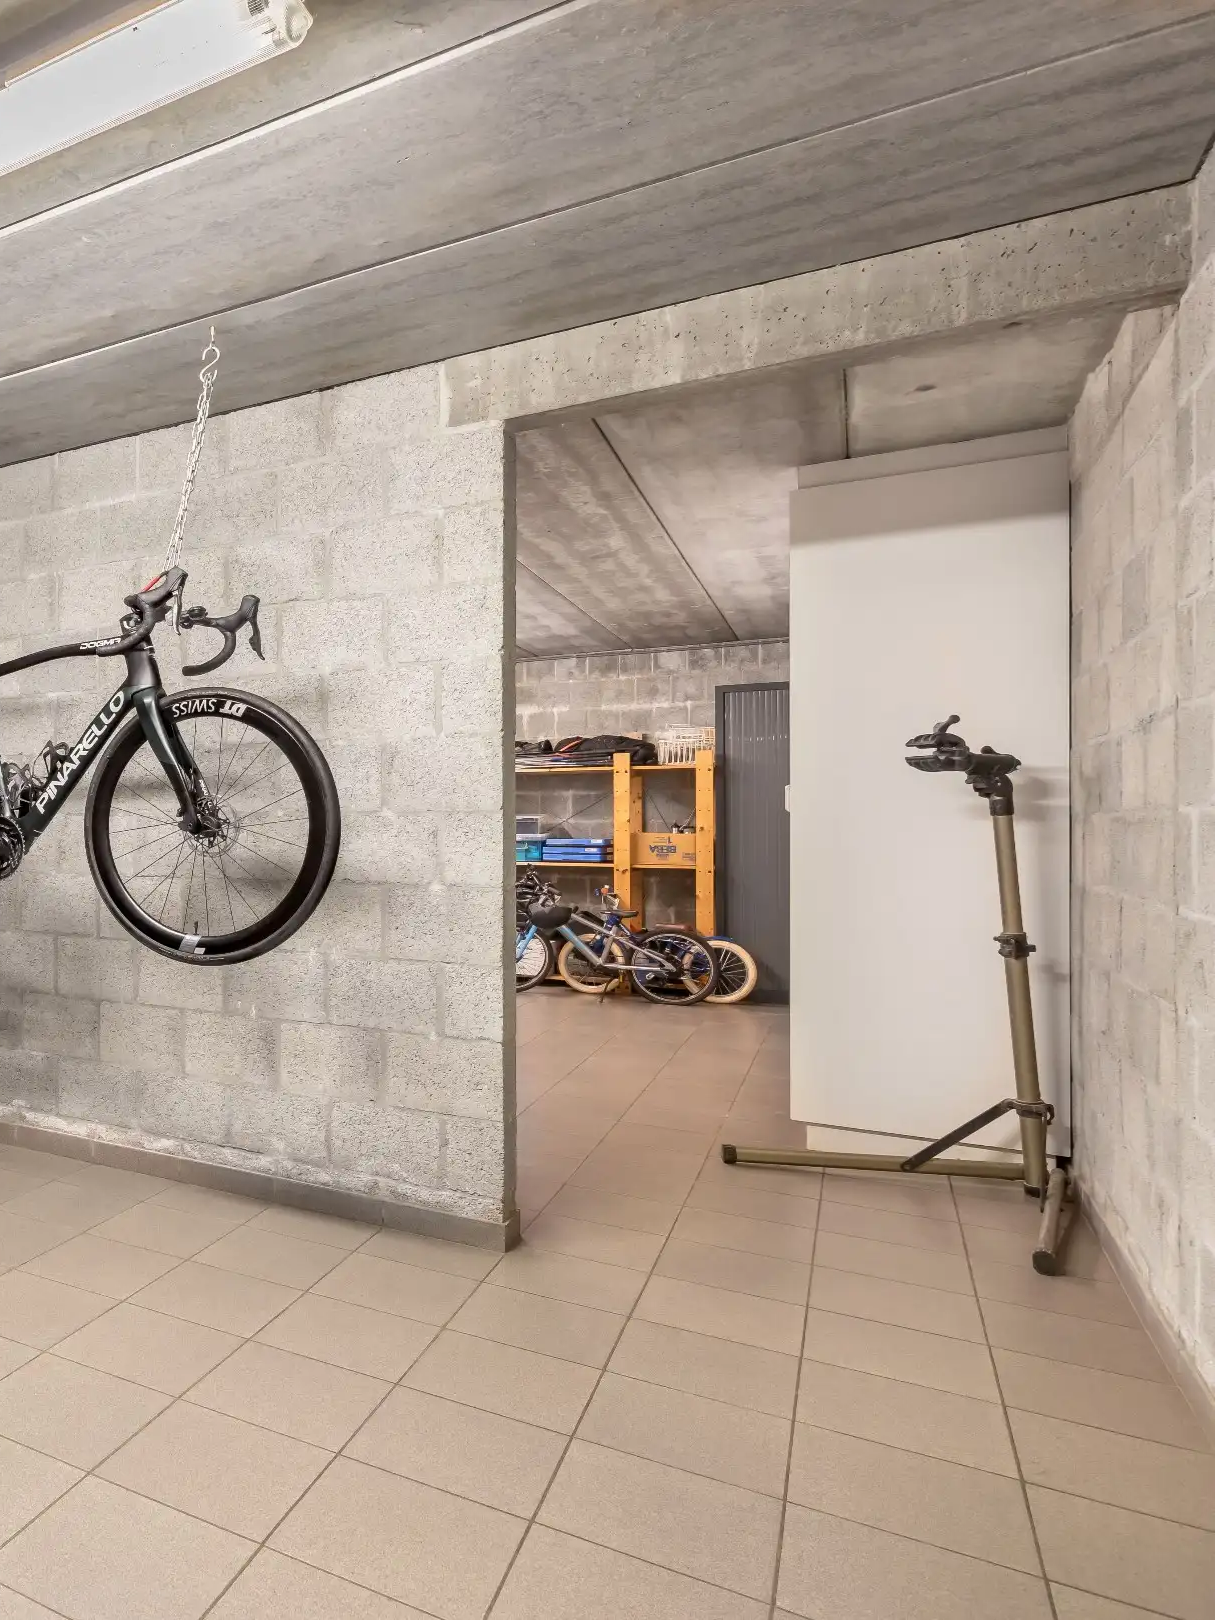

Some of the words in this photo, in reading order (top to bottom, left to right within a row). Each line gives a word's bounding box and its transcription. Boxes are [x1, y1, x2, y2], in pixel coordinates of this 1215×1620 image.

[79, 637, 122, 650] DOGMA
[171, 698, 218, 718] SWISS
[219, 699, 248, 718] DT
[35, 690, 125, 814] PINARELLO
